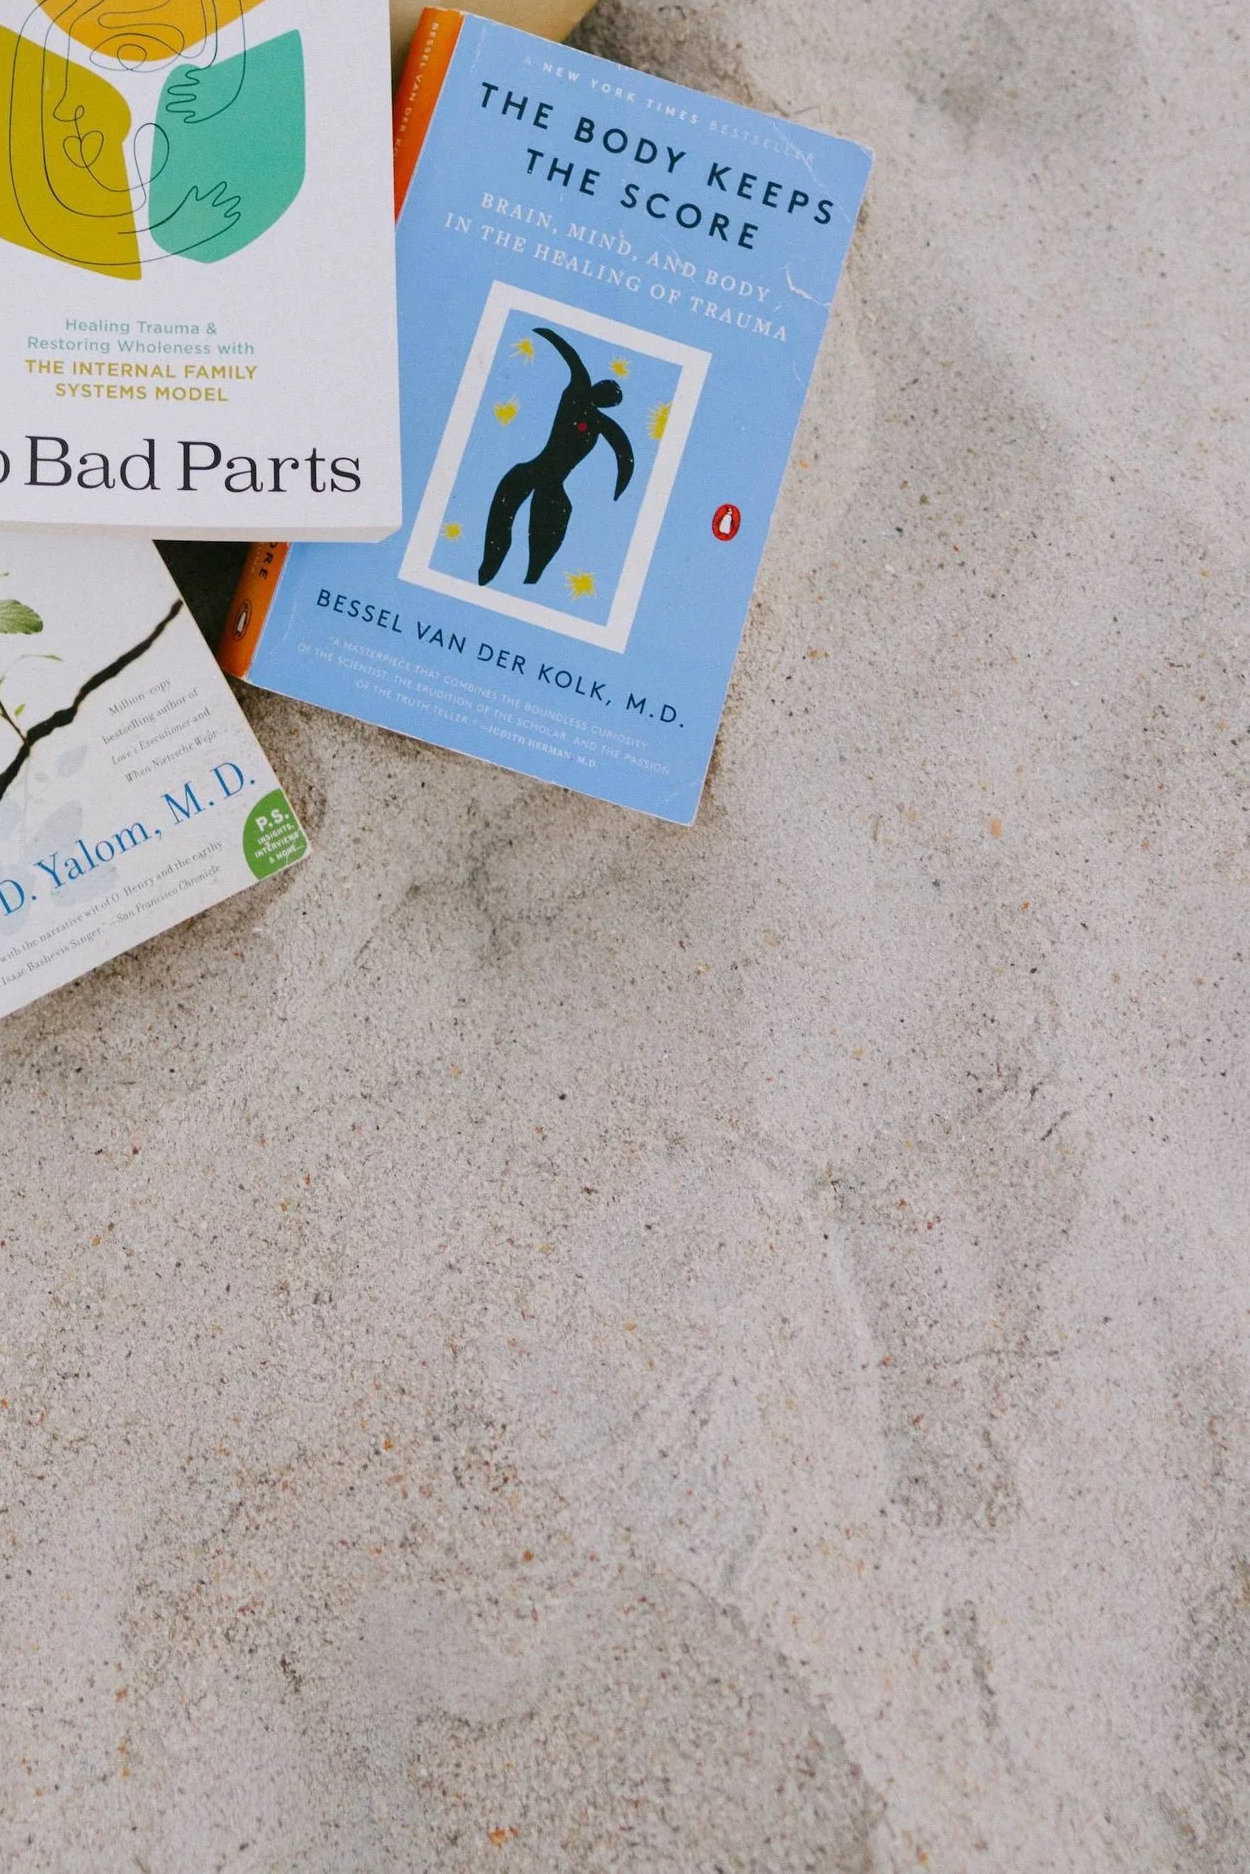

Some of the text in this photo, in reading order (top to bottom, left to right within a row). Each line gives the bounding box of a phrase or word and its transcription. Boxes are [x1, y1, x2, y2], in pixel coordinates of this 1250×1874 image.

[399, 22, 439, 132] BESSEL VAN DER
[522, 55, 533, 69] A
[542, 61, 580, 81] NEW
[590, 78, 635, 102] YORK
[646, 97, 698, 124] TIMES
[479, 80, 834, 225] THE BODY KEEPS
[525, 146, 759, 250] THE SCORE
[444, 212, 786, 341] IN THE HEALING OF TRAUMA
[480, 191, 770, 302] BRAIN, MIND, AND BODY
[28, 336, 254, 355] Restoring Wholeness with
[65, 318, 218, 335] Healing Trauma &
[25, 359, 258, 380] THE INTERNAL FAMILY
[55, 382, 229, 402] SYSTEMS MODEL
[24, 435, 161, 491] Bad
[176, 440, 361, 493] Parts
[316, 588, 684, 728] BESSEL VAN DER KOLK, M.D.
[101, 686, 198, 745] bestselling author of
[124, 727, 216, 783] When Nietzsche Wept
[254, 807, 290, 832] P.S.
[33, 820, 163, 889] Yalom,
[1, 968, 24, 986] Isaac
[26, 945, 70, 973] Bashevis
[134, 887, 178, 916] Francisco
[177, 864, 220, 891] Chronicle
[20, 936, 38, 953] the
[38, 914, 82, 943] narrative
[83, 904, 100, 917] wit
[99, 897, 111, 909] of
[123, 877, 154, 897] Henry
[155, 863, 174, 880] and
[173, 857, 190, 870] the
[191, 841, 222, 861] earthy
